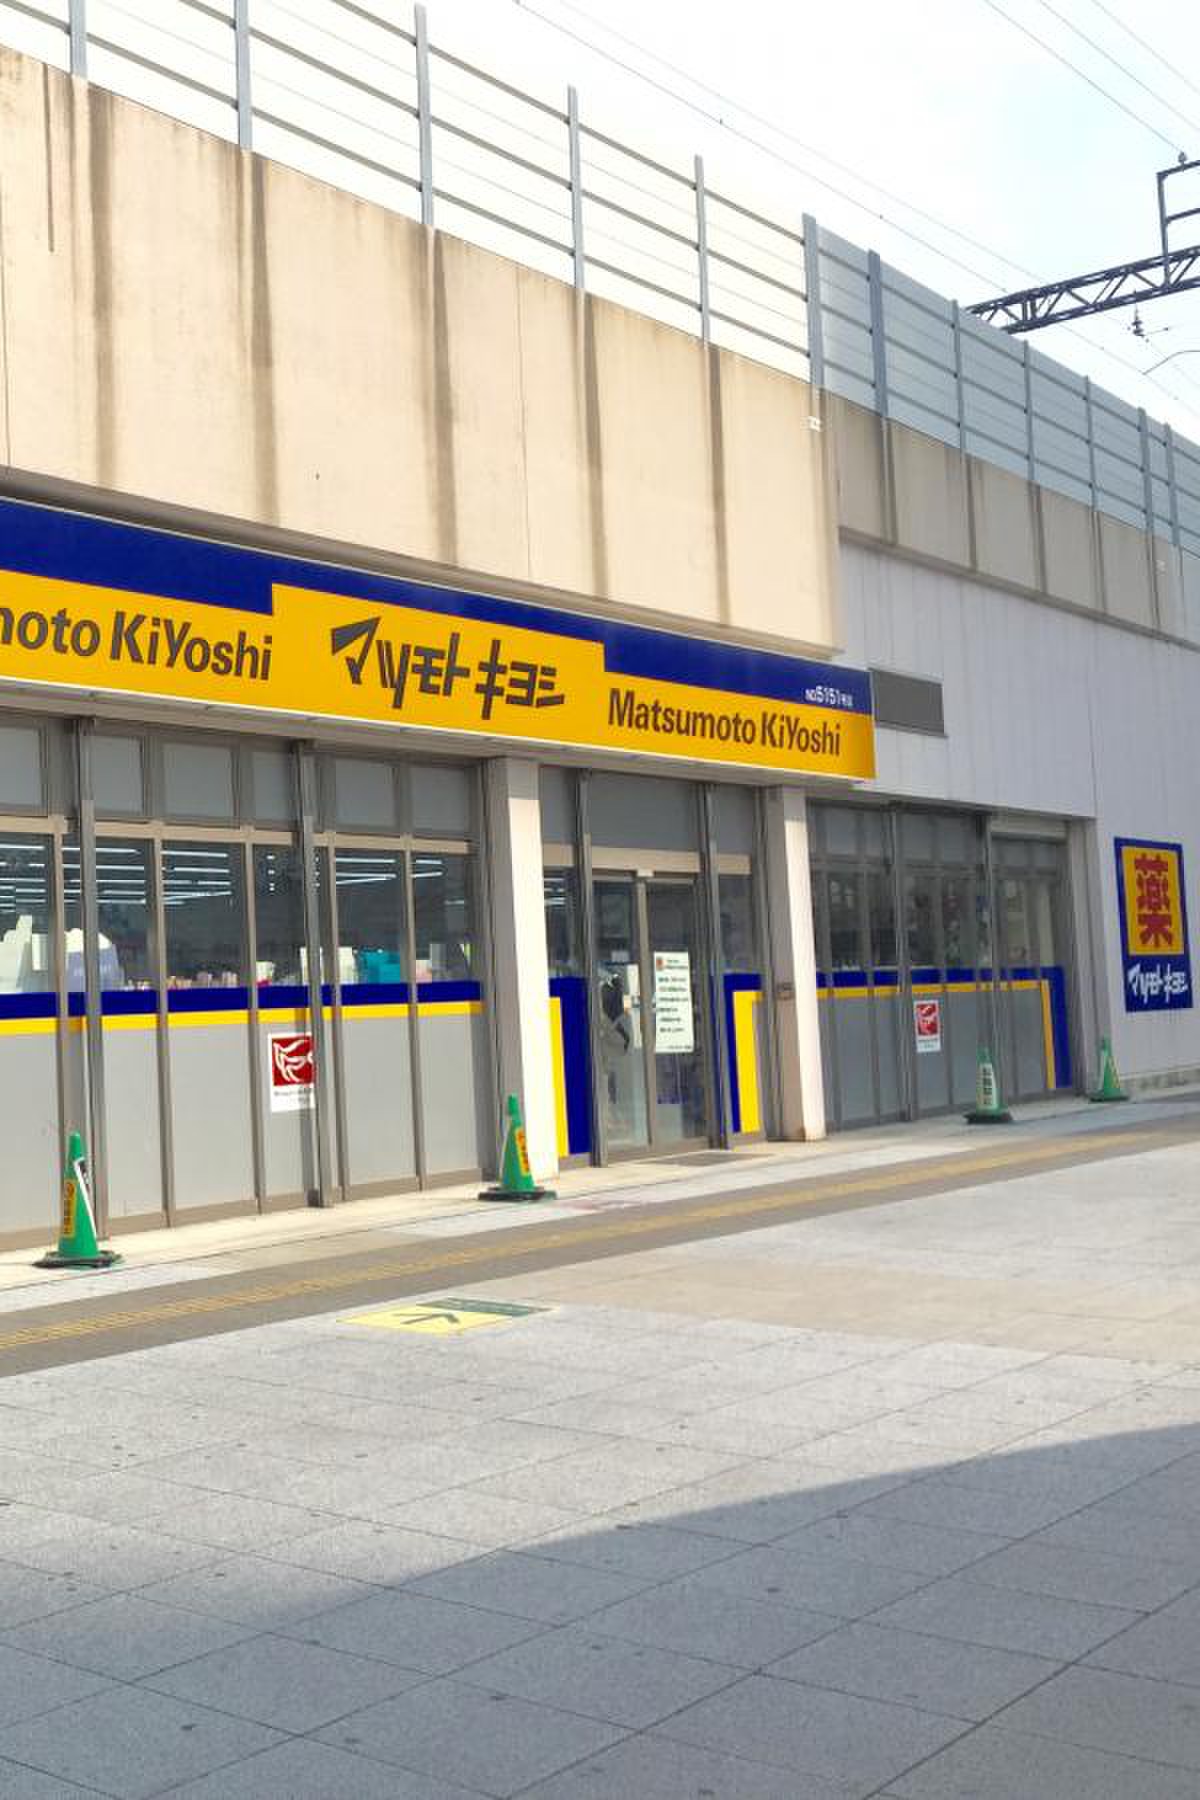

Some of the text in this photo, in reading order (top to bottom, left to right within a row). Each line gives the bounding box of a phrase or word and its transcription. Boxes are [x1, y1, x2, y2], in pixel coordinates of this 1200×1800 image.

[109, 610, 273, 681] KiYoshi
[330, 615, 567, 722] マツモトキヨシ
[607, 687, 842, 757] Matsumoto KiYoshi
[1134, 852, 1174, 949] 薬
